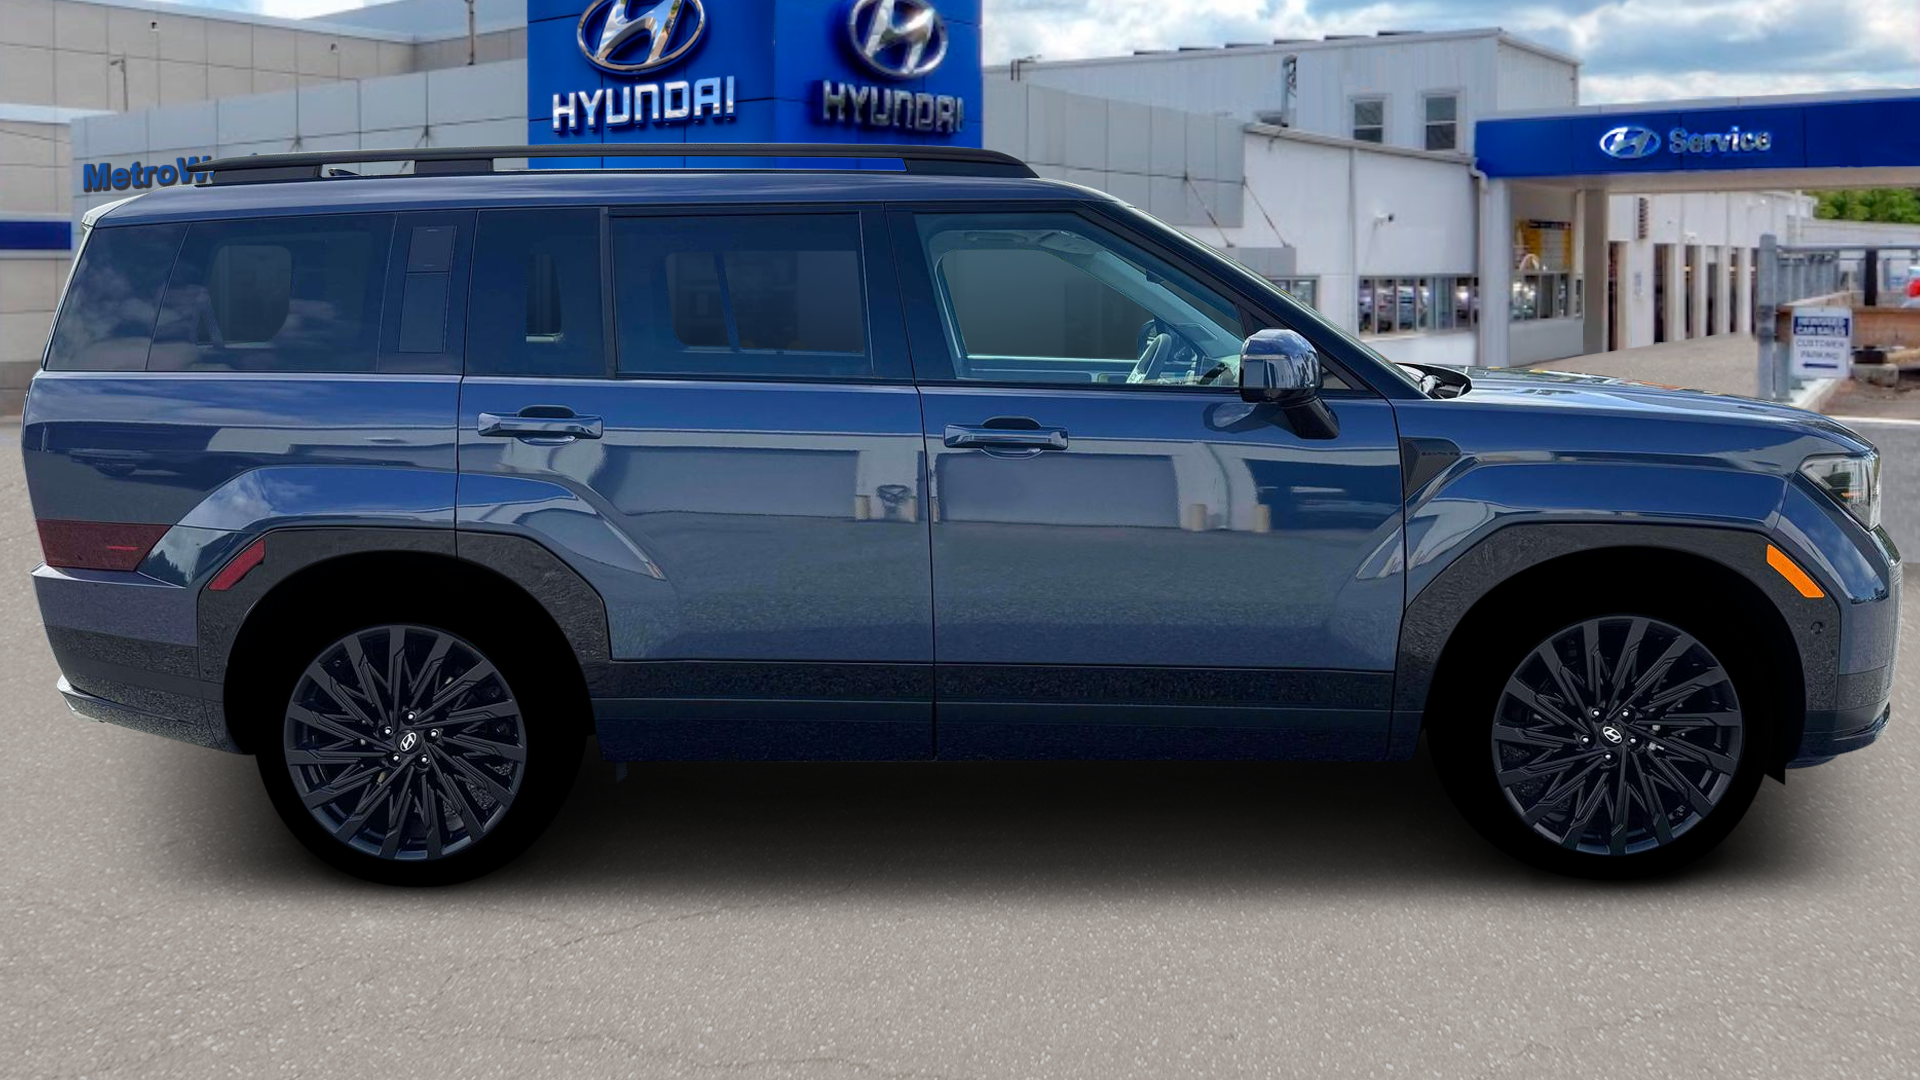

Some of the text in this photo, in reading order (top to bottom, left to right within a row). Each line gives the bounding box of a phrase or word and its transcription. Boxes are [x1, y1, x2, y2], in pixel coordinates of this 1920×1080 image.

[552, 75, 735, 130] HYUNDAI
[823, 79, 964, 133] HYUNDAI
[1669, 125, 1772, 153] Service
[83, 155, 214, 193] MetroW
